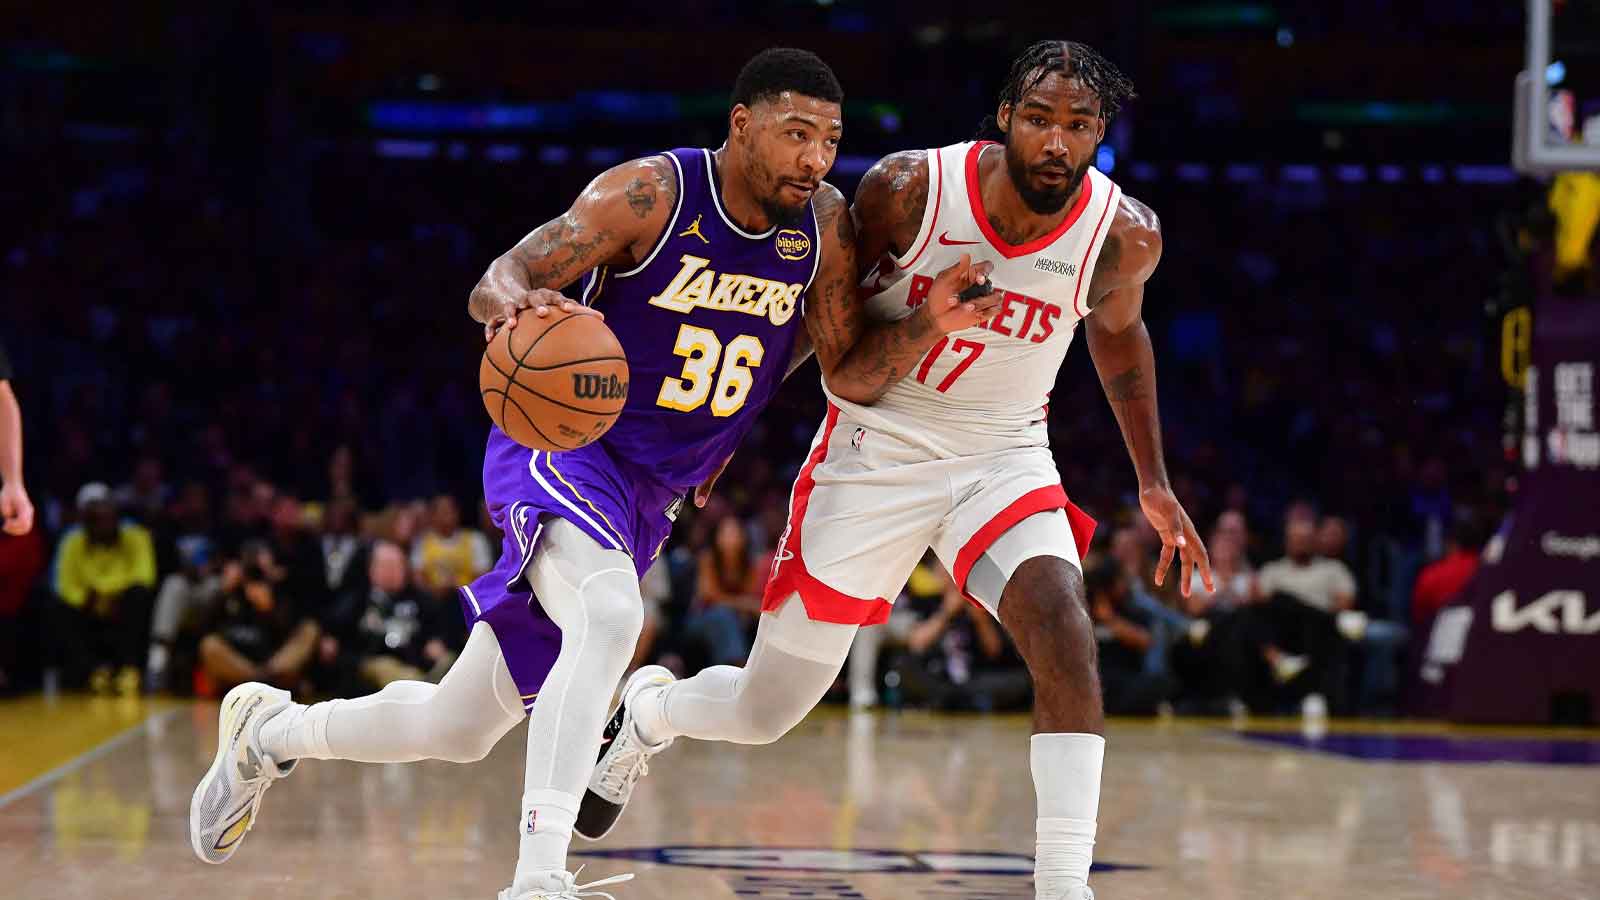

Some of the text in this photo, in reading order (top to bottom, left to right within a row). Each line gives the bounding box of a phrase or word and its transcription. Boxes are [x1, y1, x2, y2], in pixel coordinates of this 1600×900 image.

[777, 237, 808, 251] bibigo
[1035, 261, 1074, 276] HERMANN
[1036, 257, 1076, 272] MEMORIAL
[648, 254, 803, 326] LAKERS
[906, 273, 1062, 344] RETS
[656, 324, 765, 417] 36
[916, 335, 986, 393] 17
[1491, 589, 1600, 634] KI
